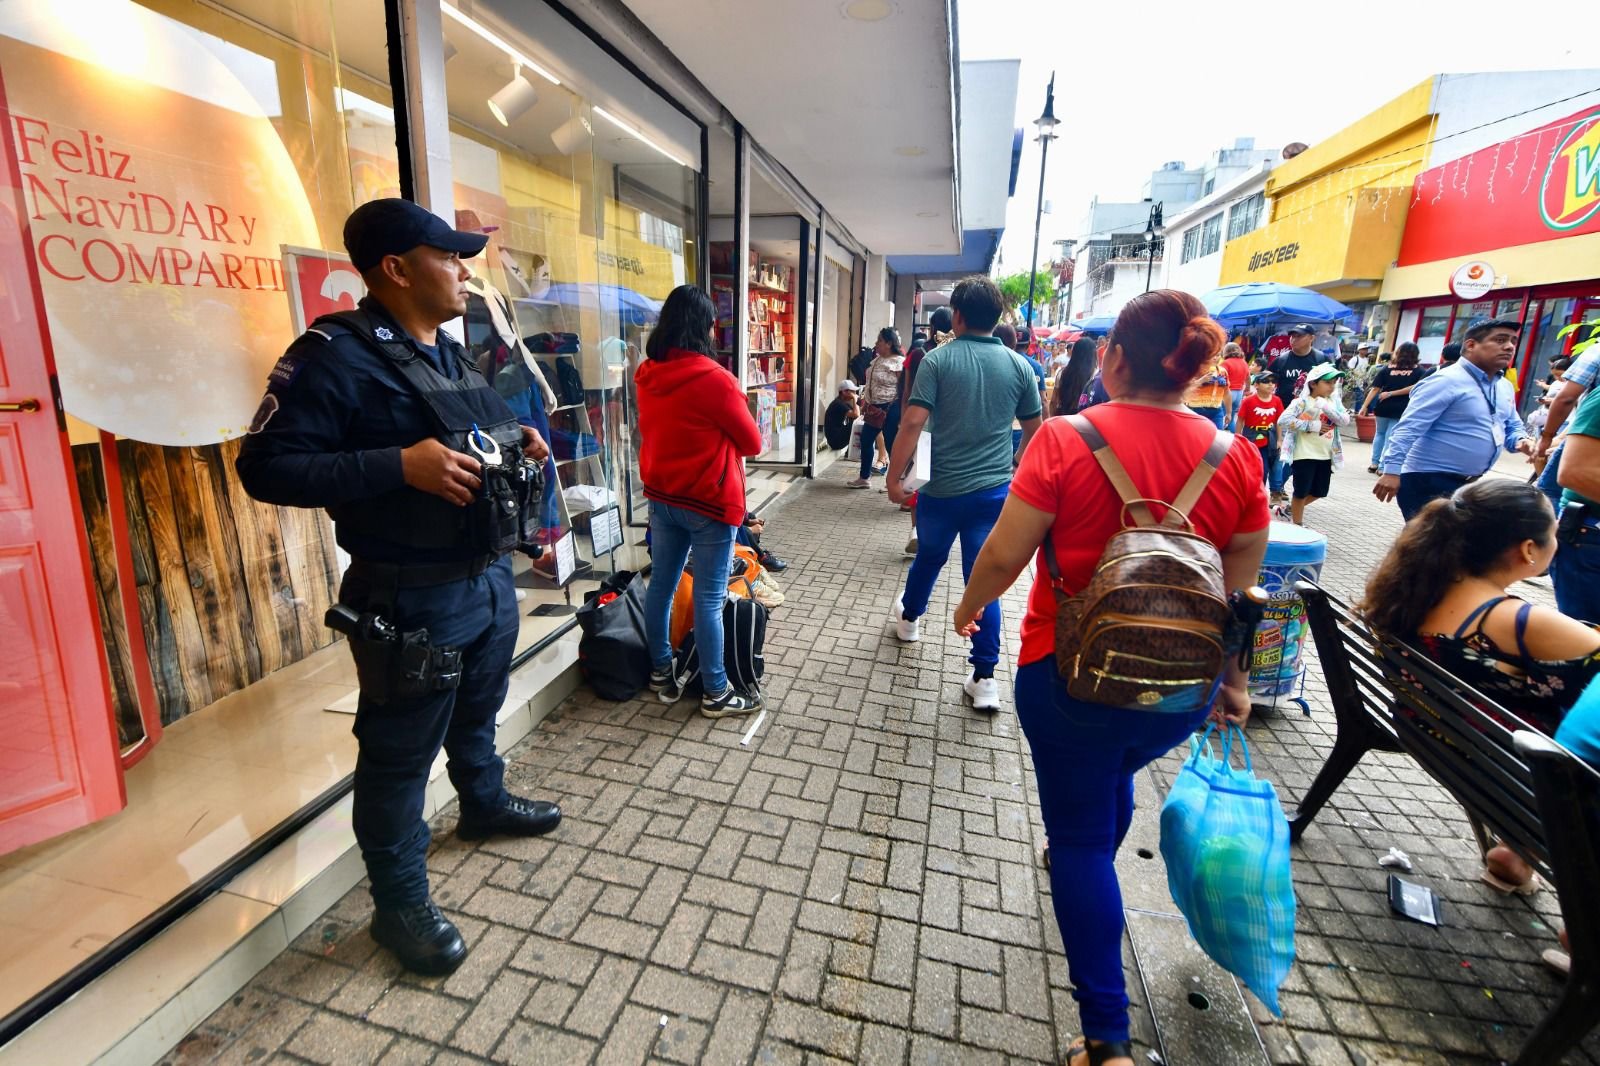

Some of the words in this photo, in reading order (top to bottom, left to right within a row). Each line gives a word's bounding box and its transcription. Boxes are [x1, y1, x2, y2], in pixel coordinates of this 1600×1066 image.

[10, 114, 136, 183] Feliz
[23, 172, 237, 244] NaviDAR
[238, 215, 257, 246] y
